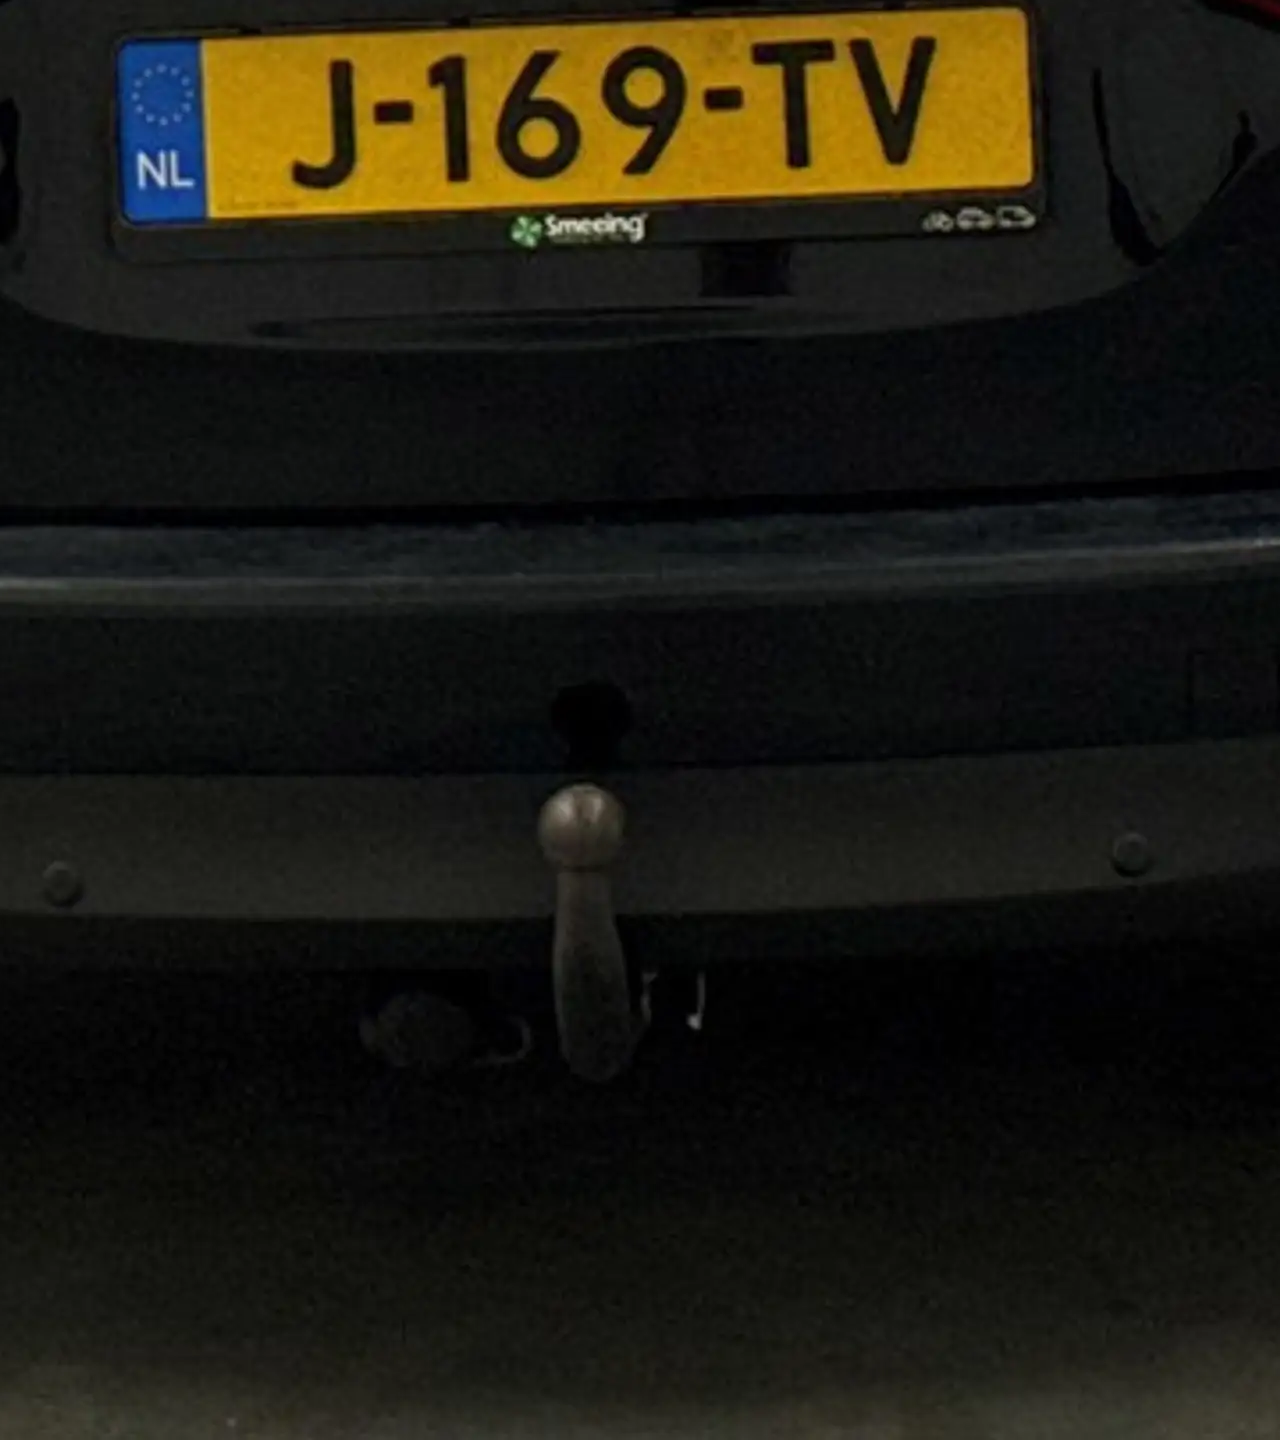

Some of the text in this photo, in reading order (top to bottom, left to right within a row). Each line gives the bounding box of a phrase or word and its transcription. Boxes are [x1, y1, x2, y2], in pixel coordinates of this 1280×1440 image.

[291, 36, 937, 190] J-169-TV
[136, 151, 195, 190] NL
[544, 212, 647, 244] Smeeing
